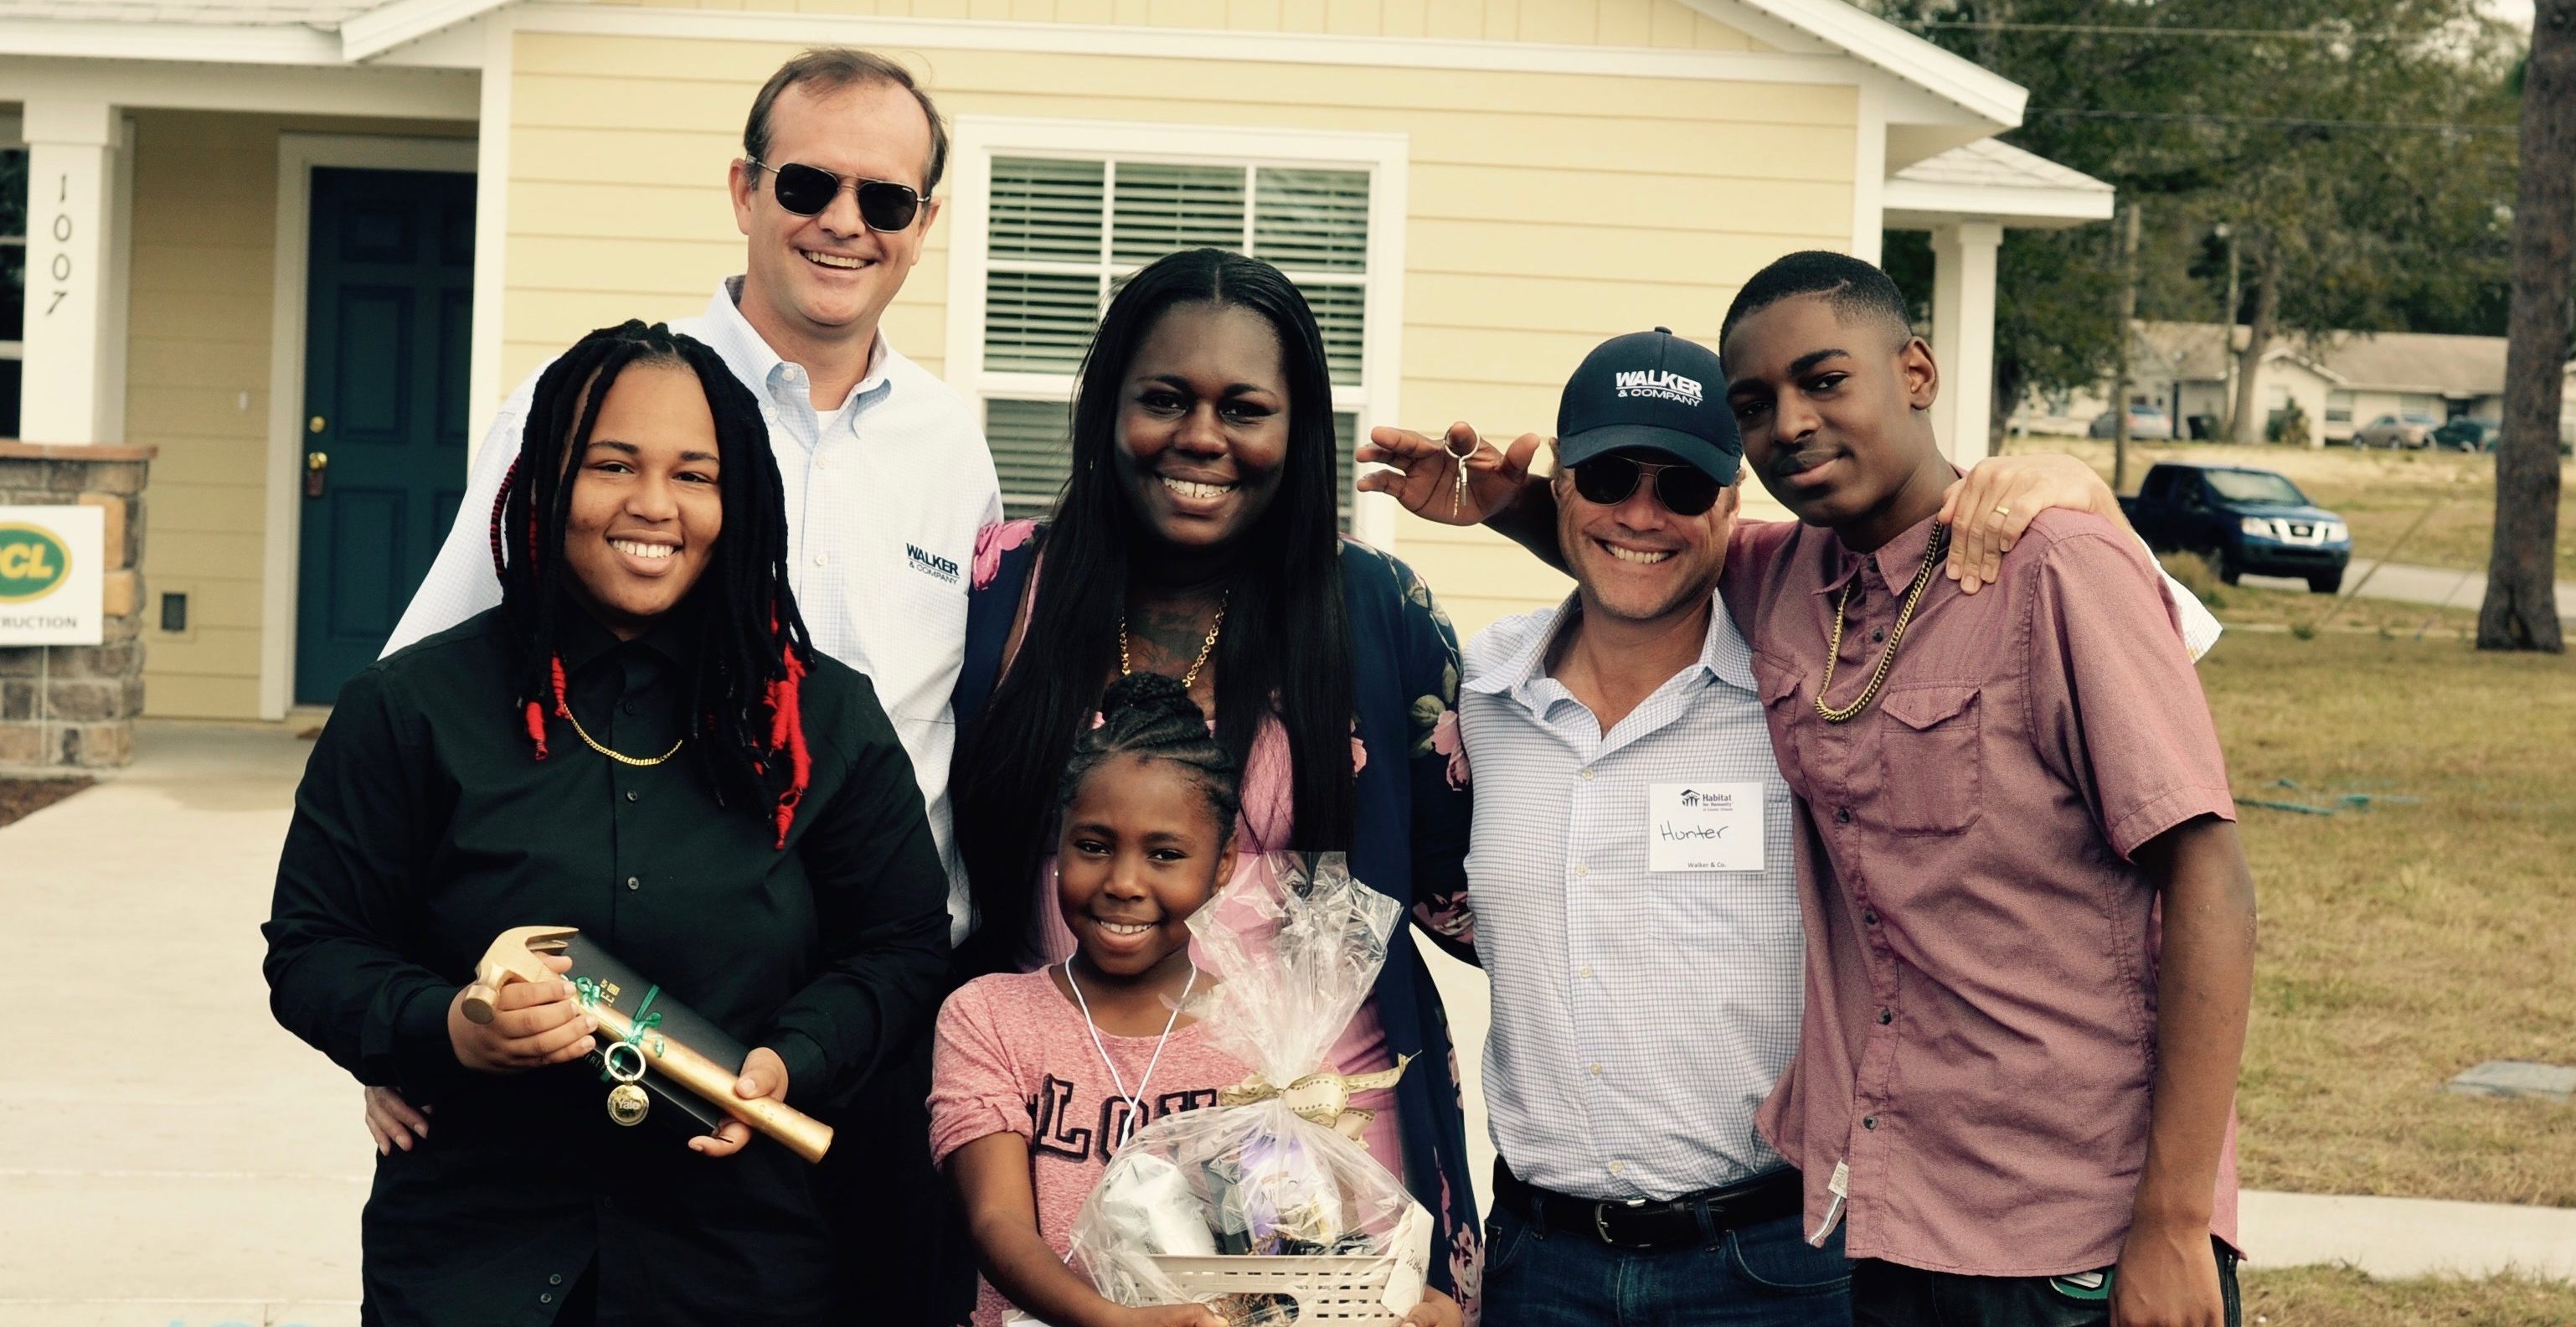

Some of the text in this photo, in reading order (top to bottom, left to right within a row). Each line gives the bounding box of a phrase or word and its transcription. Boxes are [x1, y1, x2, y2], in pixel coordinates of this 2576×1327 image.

[47, 174, 72, 315] 1007
[1615, 369, 1703, 399] WALKER
[1617, 389, 1701, 407] & COMPANY
[0, 543, 54, 578] CL
[906, 542, 959, 576] WALKER
[916, 563, 958, 585] COMPANY
[0, 616, 77, 628] RUCTION
[1703, 793, 1732, 802] Habitat
[1660, 820, 1729, 841] Hunter
[617, 1099, 641, 1110] Yale
